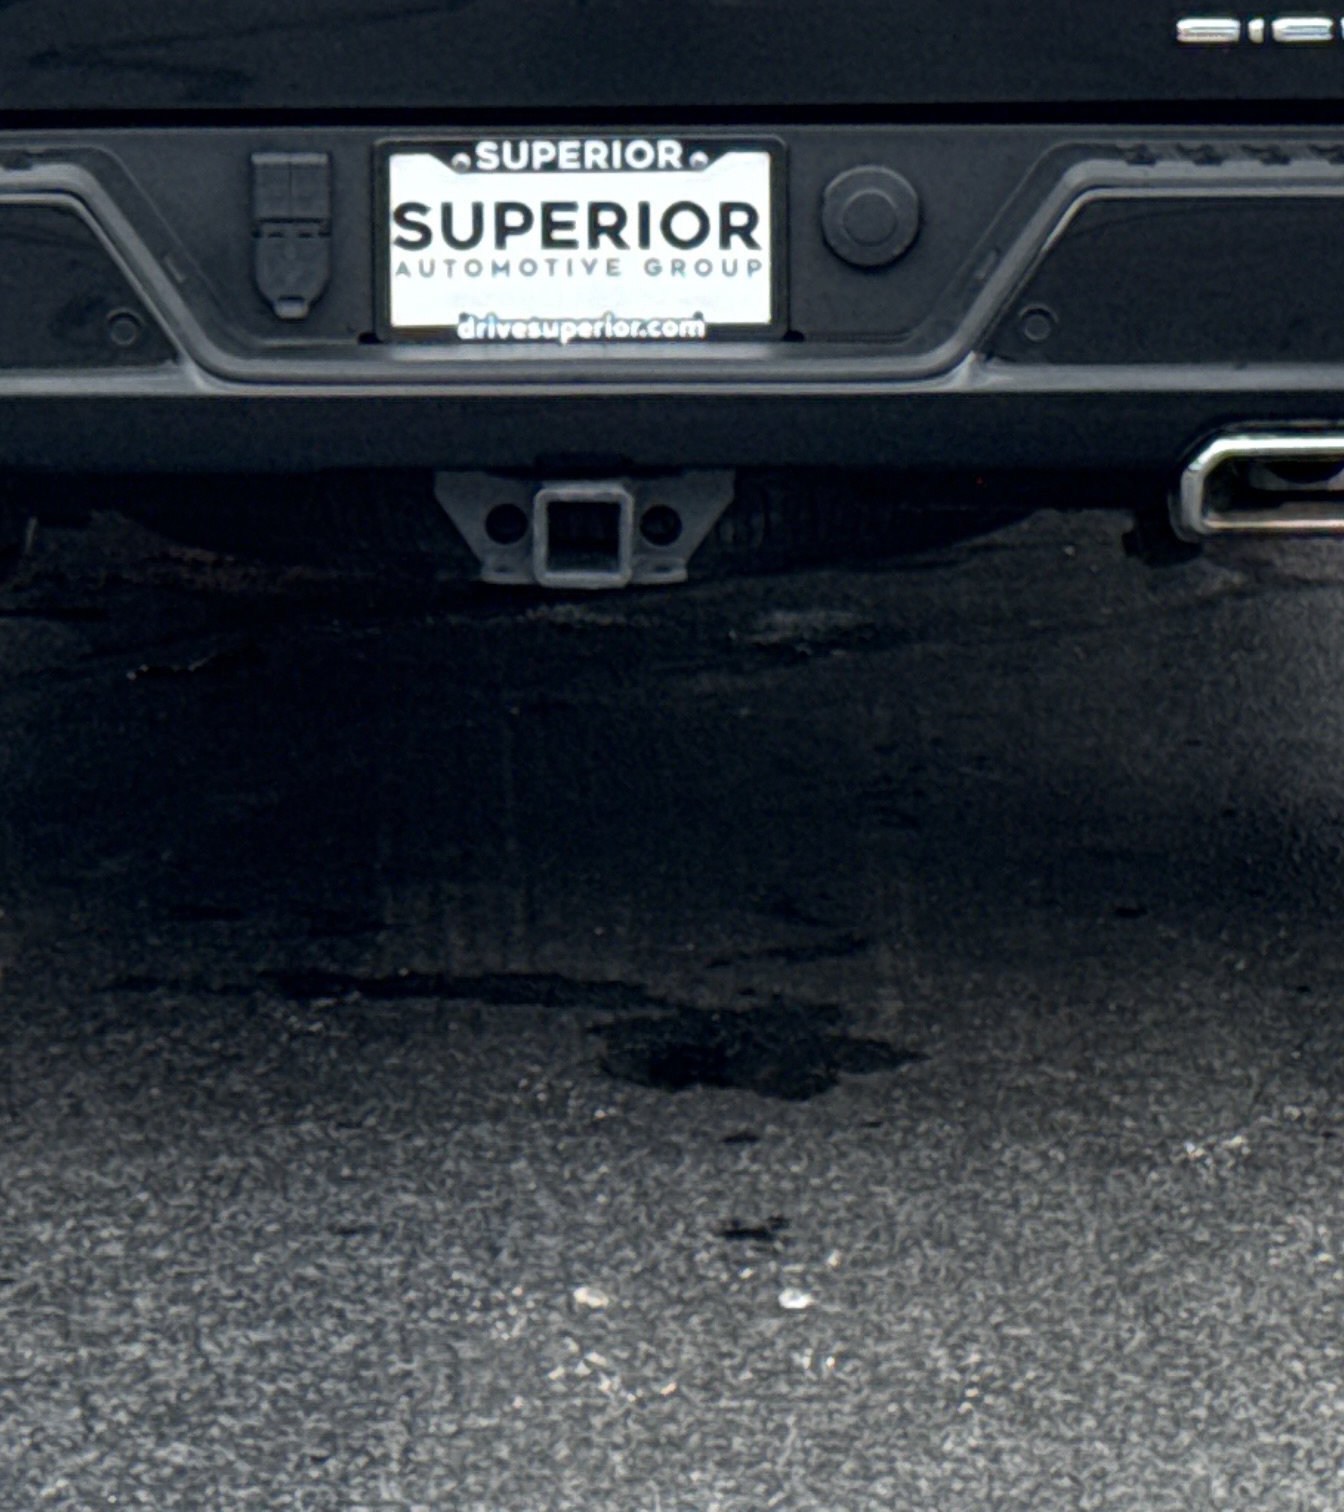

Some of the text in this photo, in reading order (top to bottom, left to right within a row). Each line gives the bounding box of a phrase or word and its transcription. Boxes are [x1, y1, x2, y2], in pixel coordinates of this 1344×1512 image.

[475, 139, 684, 171] SUPERIOR
[393, 200, 763, 251] SUPERIOR
[394, 258, 763, 278] AUTOMOTIVE GROUP
[457, 314, 705, 345] drivesuperior.com
